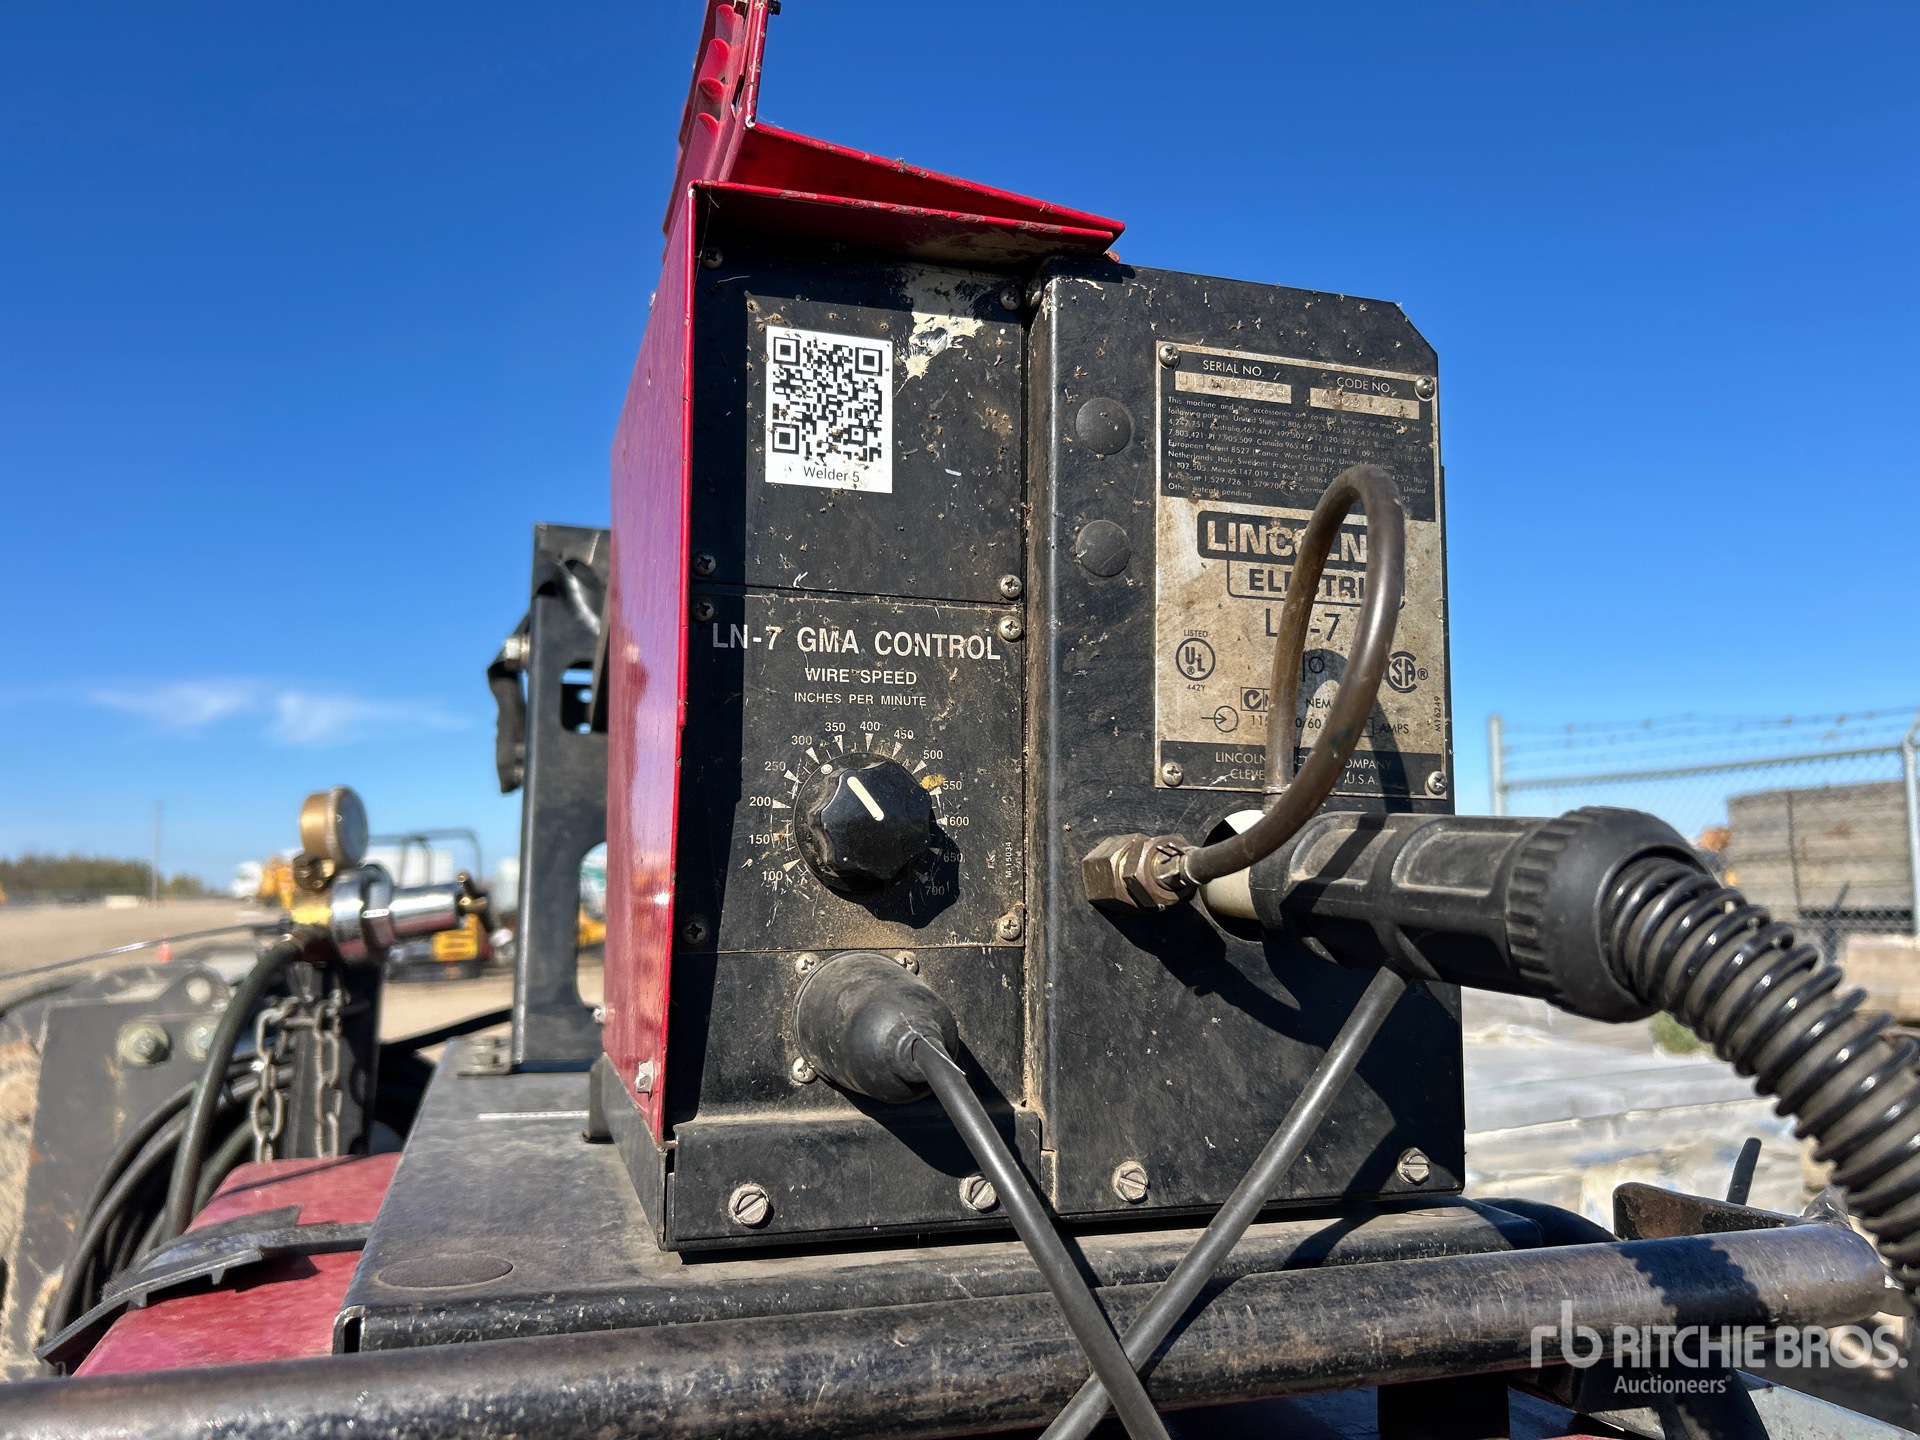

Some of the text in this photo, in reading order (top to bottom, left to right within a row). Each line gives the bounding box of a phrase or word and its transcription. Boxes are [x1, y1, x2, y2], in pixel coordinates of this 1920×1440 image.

[1202, 359, 1264, 377] SERIAL NO.
[1336, 376, 1368, 390] CODE
[1168, 396, 1182, 404] This
[1186, 398, 1215, 408] machine
[1219, 402, 1234, 410] and
[1238, 404, 1249, 412] the
[1253, 406, 1291, 417] accessories
[1340, 416, 1349, 425] by
[1258, 417, 1278, 426] States
[1256, 438, 1283, 447] Canada
[1167, 438, 1203, 450] European
[1205, 442, 1228, 452] Patent
[1230, 445, 1249, 454] 8527
[1283, 451, 1300, 460] West
[803, 465, 860, 483] Welder 5
[1413, 476, 1427, 485] Italy
[1221, 487, 1251, 498] pending
[1403, 485, 1426, 494] United
[1265, 607, 1341, 642] L-7
[1183, 628, 1208, 638] LISTED
[711, 622, 1001, 660] LN-7 GMA CONTROL
[804, 667, 917, 685] WIRE SPEED
[1186, 683, 1206, 692] 442Y
[794, 691, 927, 707] INCHES PER MINUTE
[1305, 697, 1332, 709] NEM
[1434, 696, 1442, 733] M16249
[825, 721, 846, 733] 350
[860, 720, 881, 732] 400
[1378, 721, 1409, 734] AMPS
[894, 729, 914, 740] 450
[791, 735, 812, 746] 300
[923, 749, 943, 760] 500
[764, 761, 786, 772] 250
[942, 780, 963, 791] 550
[749, 796, 771, 807] 200
[950, 815, 970, 826] 600
[749, 834, 770, 845] 150
[943, 852, 963, 863] 650
[761, 870, 783, 881] 100
[925, 886, 945, 896] 700
